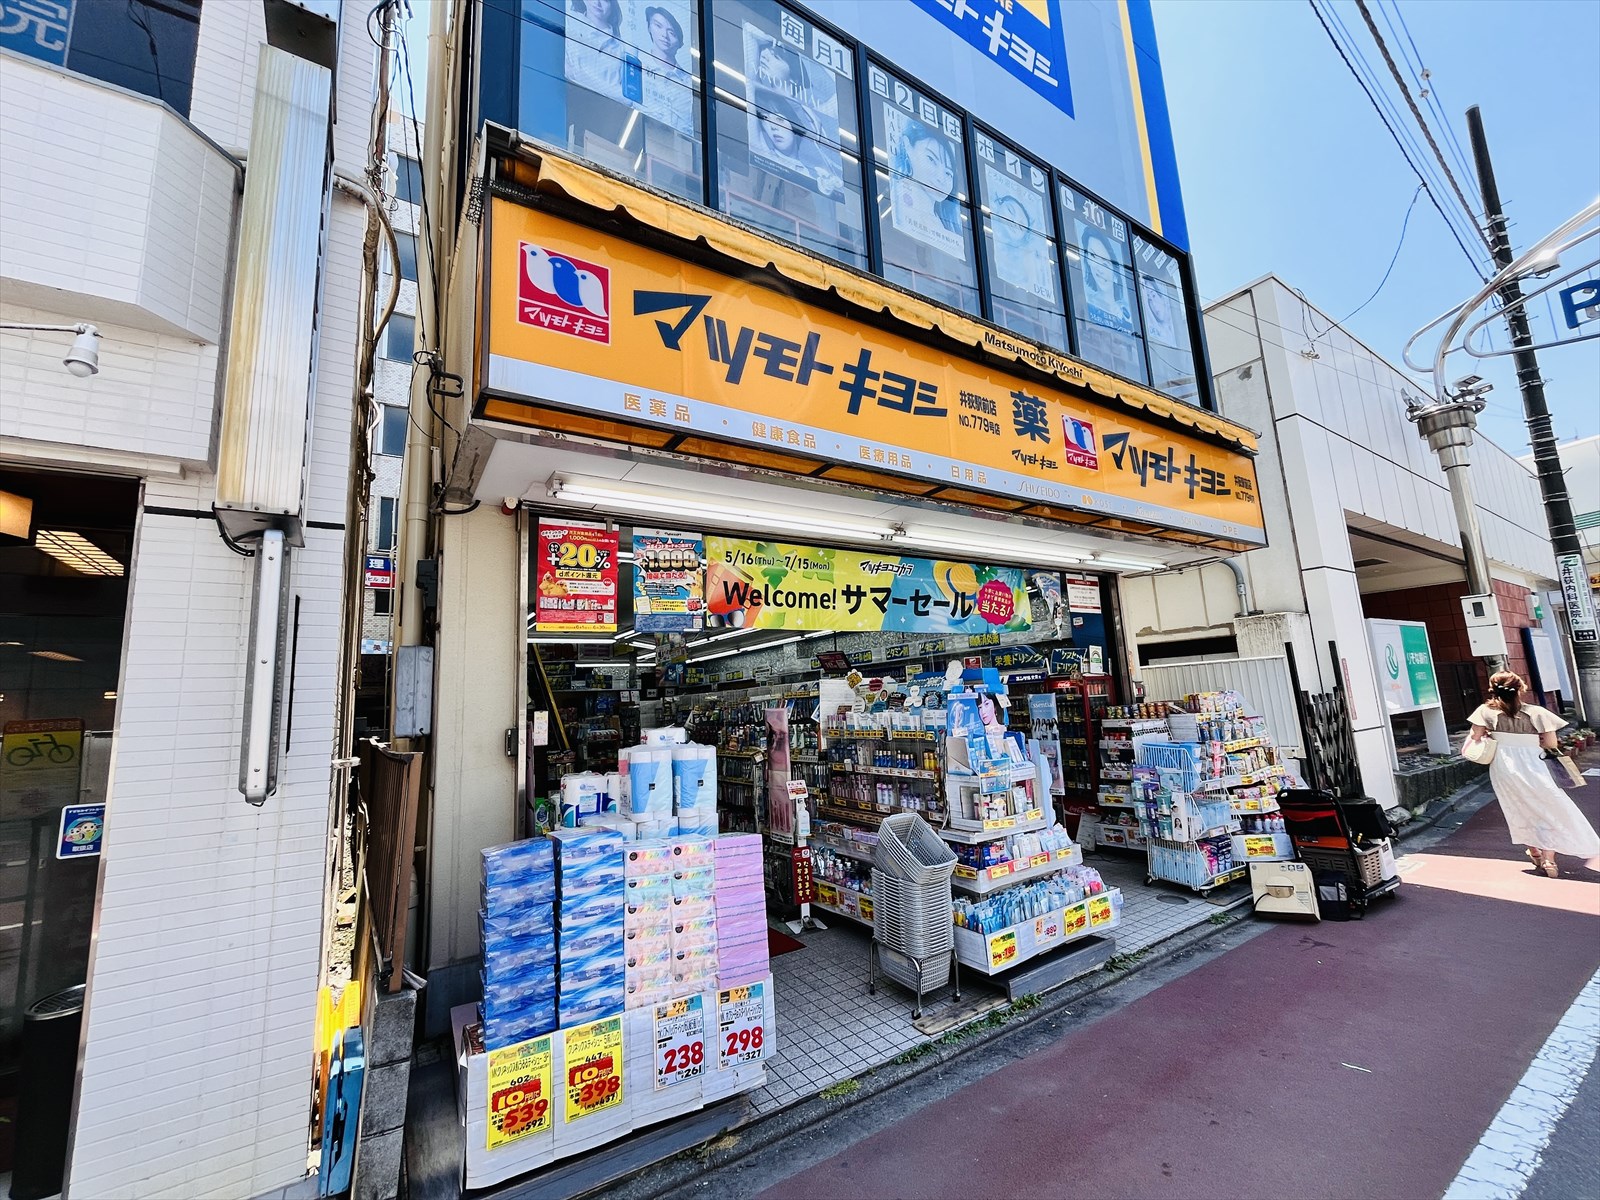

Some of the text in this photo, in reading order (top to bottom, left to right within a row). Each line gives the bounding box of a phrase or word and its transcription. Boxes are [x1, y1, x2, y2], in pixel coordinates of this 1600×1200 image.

[524, 306, 606, 337] マツモトキヨシ
[633, 289, 948, 417] マツモトキヨシ
[984, 331, 1084, 379] Matsumoto KiYoshi
[959, 390, 997, 416] 井荻駅前店
[1010, 390, 1051, 444] 薬
[624, 392, 987, 484] 医薬品 健康食品 医療用品 日用品
[1011, 449, 1058, 470] マツモトキヨシ
[1067, 452, 1097, 467] マツモトキヨシ
[1102, 432, 1231, 499] マツモトキヨシ
[1016, 480, 1061, 499] SHISEIDO
[859, 560, 914, 577] マツキヨココカラ
[723, 580, 837, 610] Welcome!
[841, 583, 973, 618] サマーセール
[995, 653, 1043, 666] 栄養ドリンク
